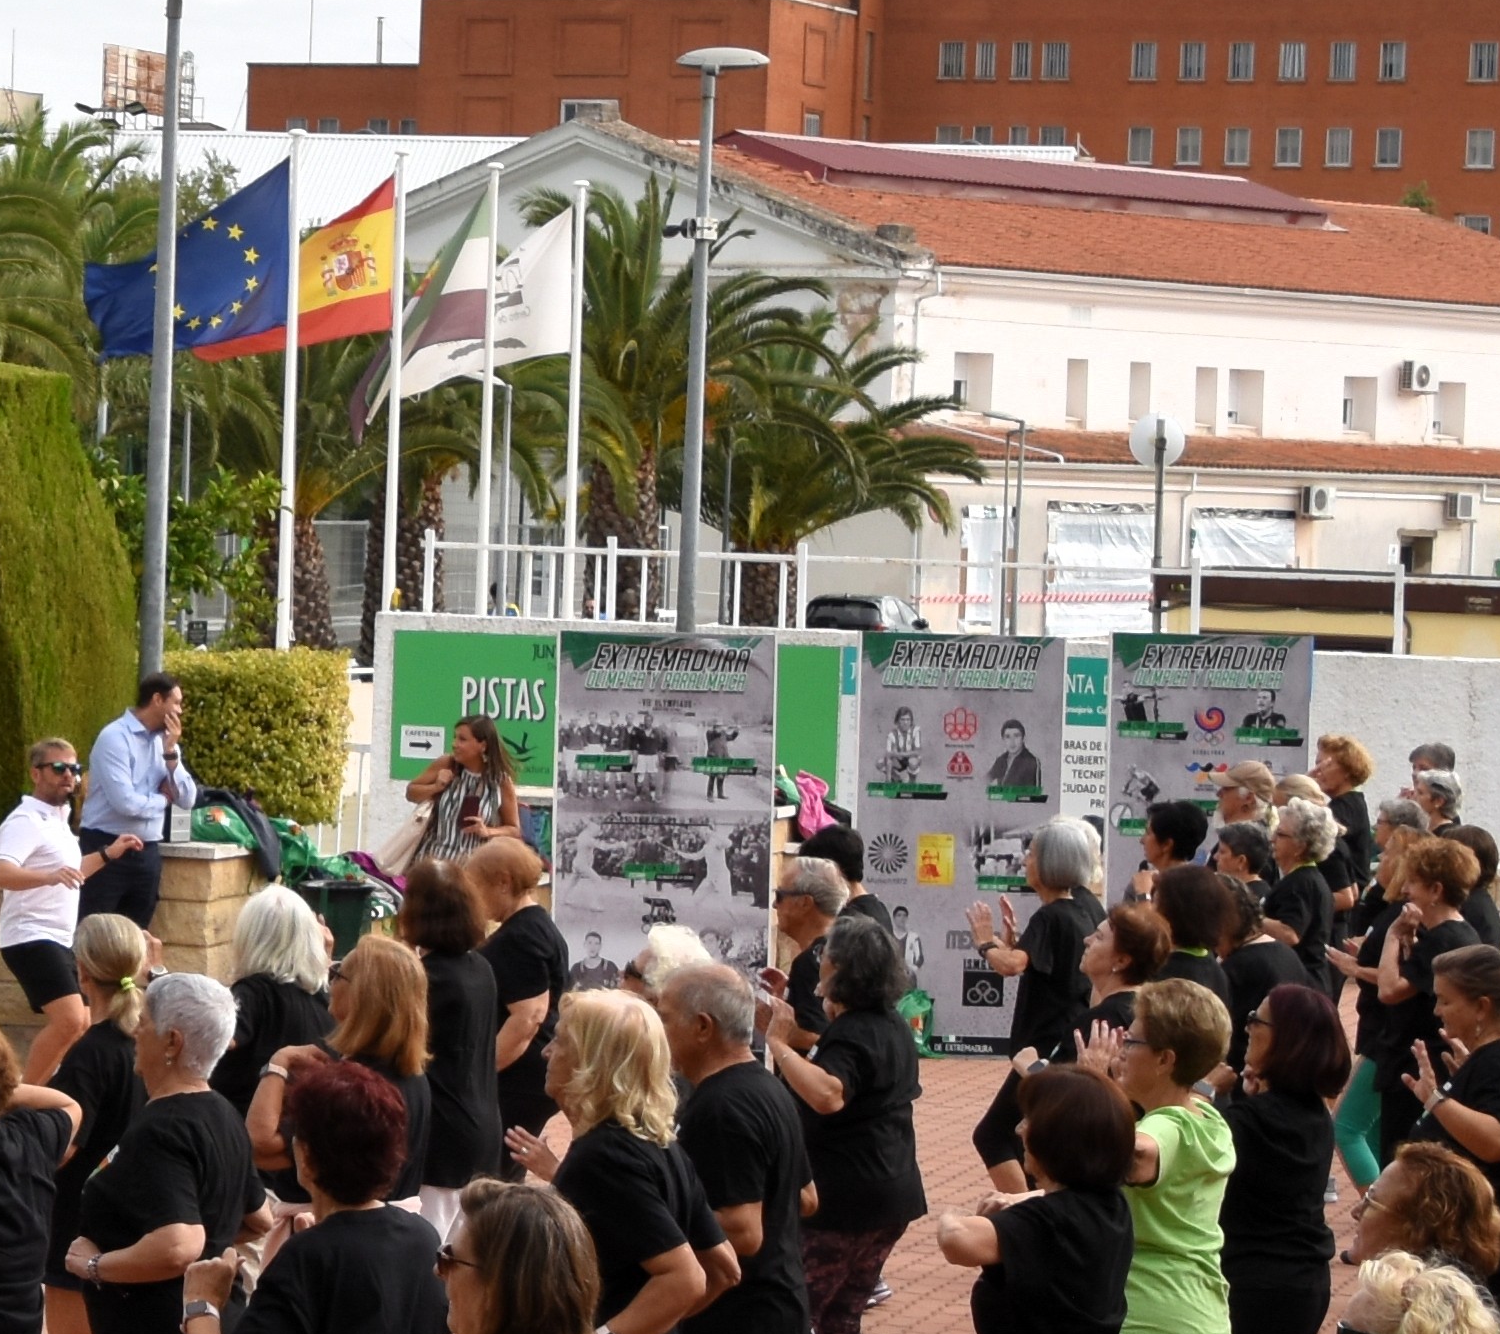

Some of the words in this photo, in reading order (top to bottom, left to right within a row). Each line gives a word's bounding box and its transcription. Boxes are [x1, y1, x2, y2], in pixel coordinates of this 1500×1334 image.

[594, 643, 751, 673] EXTREMADURA
[891, 640, 1041, 671] EXTREMADURA
[1141, 644, 1288, 673] EXTREMADURA
[648, 670, 659, 692] Y
[943, 668, 954, 689] Y
[1191, 670, 1201, 689] Y
[460, 675, 546, 721] PISTAS
[1089, 741, 1102, 752] DE
[933, 1043, 943, 1053] DE
[944, 1044, 993, 1055] EXTREMADURA
